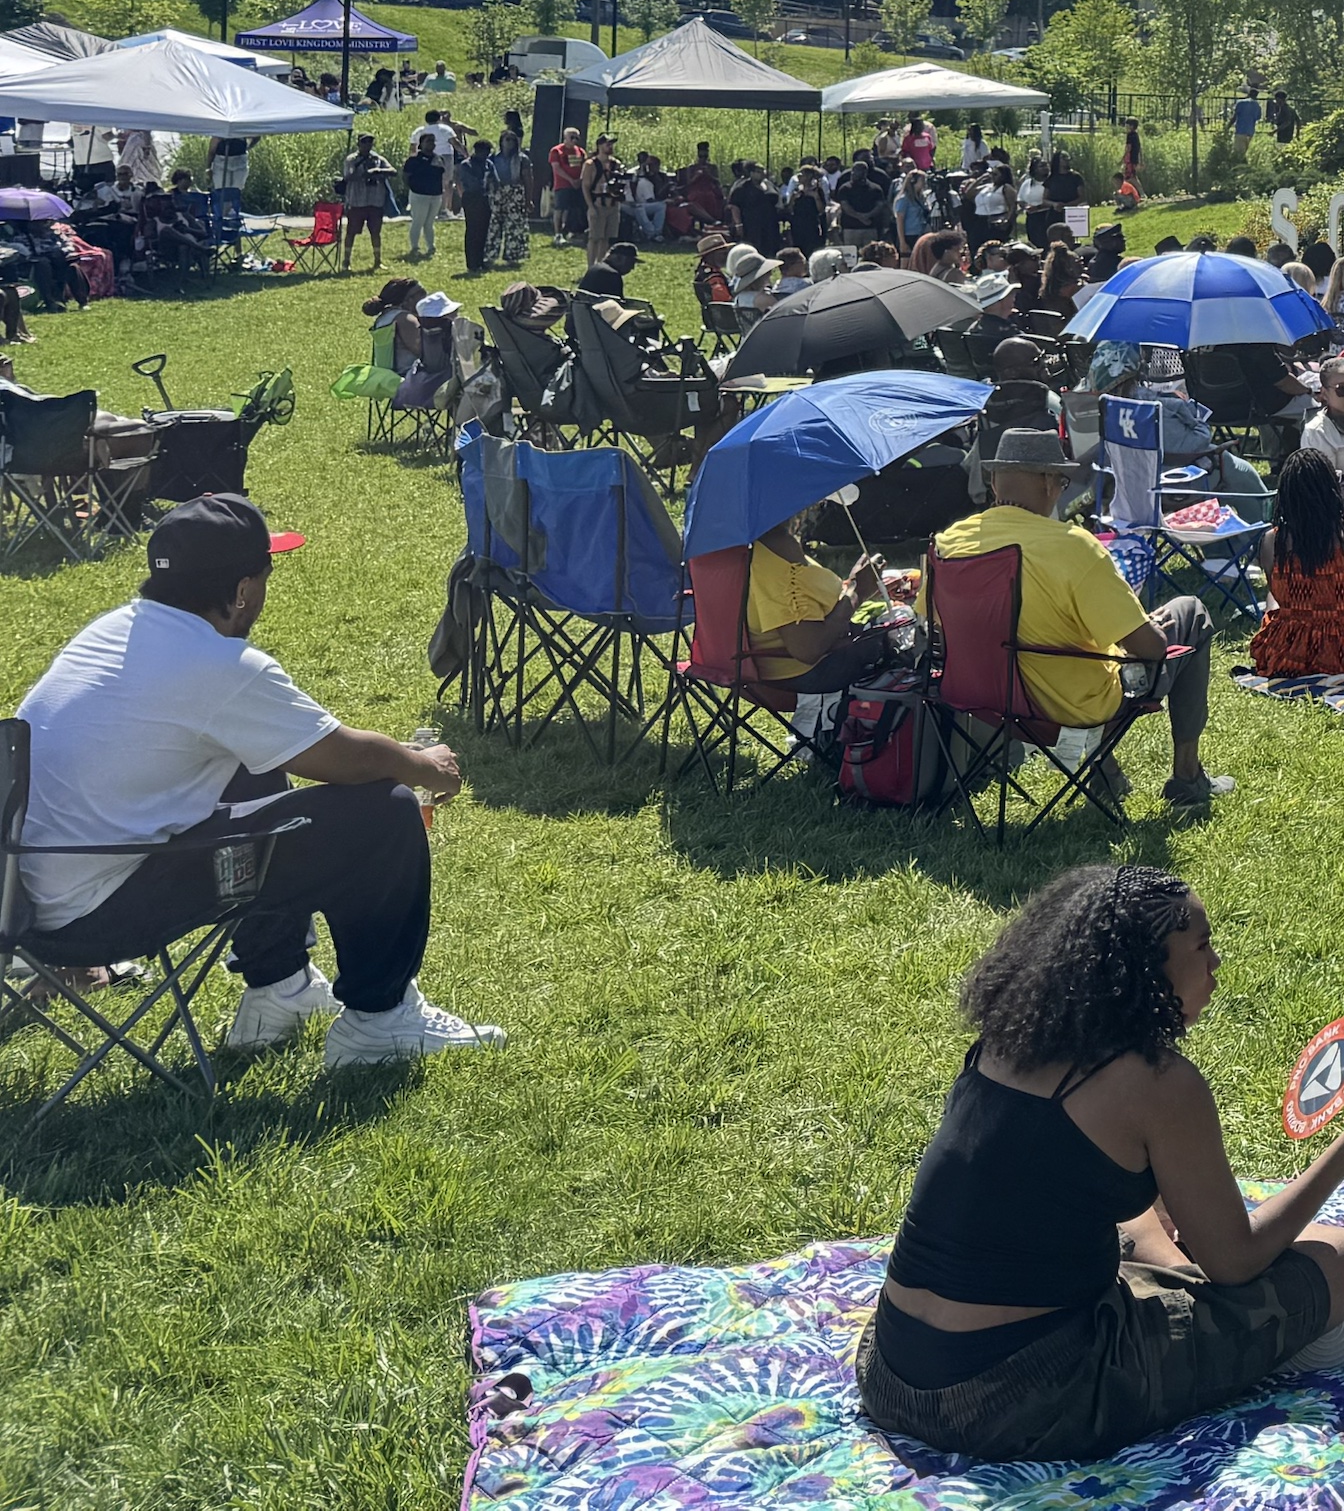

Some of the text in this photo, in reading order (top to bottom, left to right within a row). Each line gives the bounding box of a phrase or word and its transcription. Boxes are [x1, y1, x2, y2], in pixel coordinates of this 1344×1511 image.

[240, 37, 267, 46] FIRST
[269, 38, 295, 47] LOVE
[296, 39, 344, 48] KINGDOM
[1308, 1024, 1341, 1055] BANK
[1310, 1097, 1343, 1131] BANK
